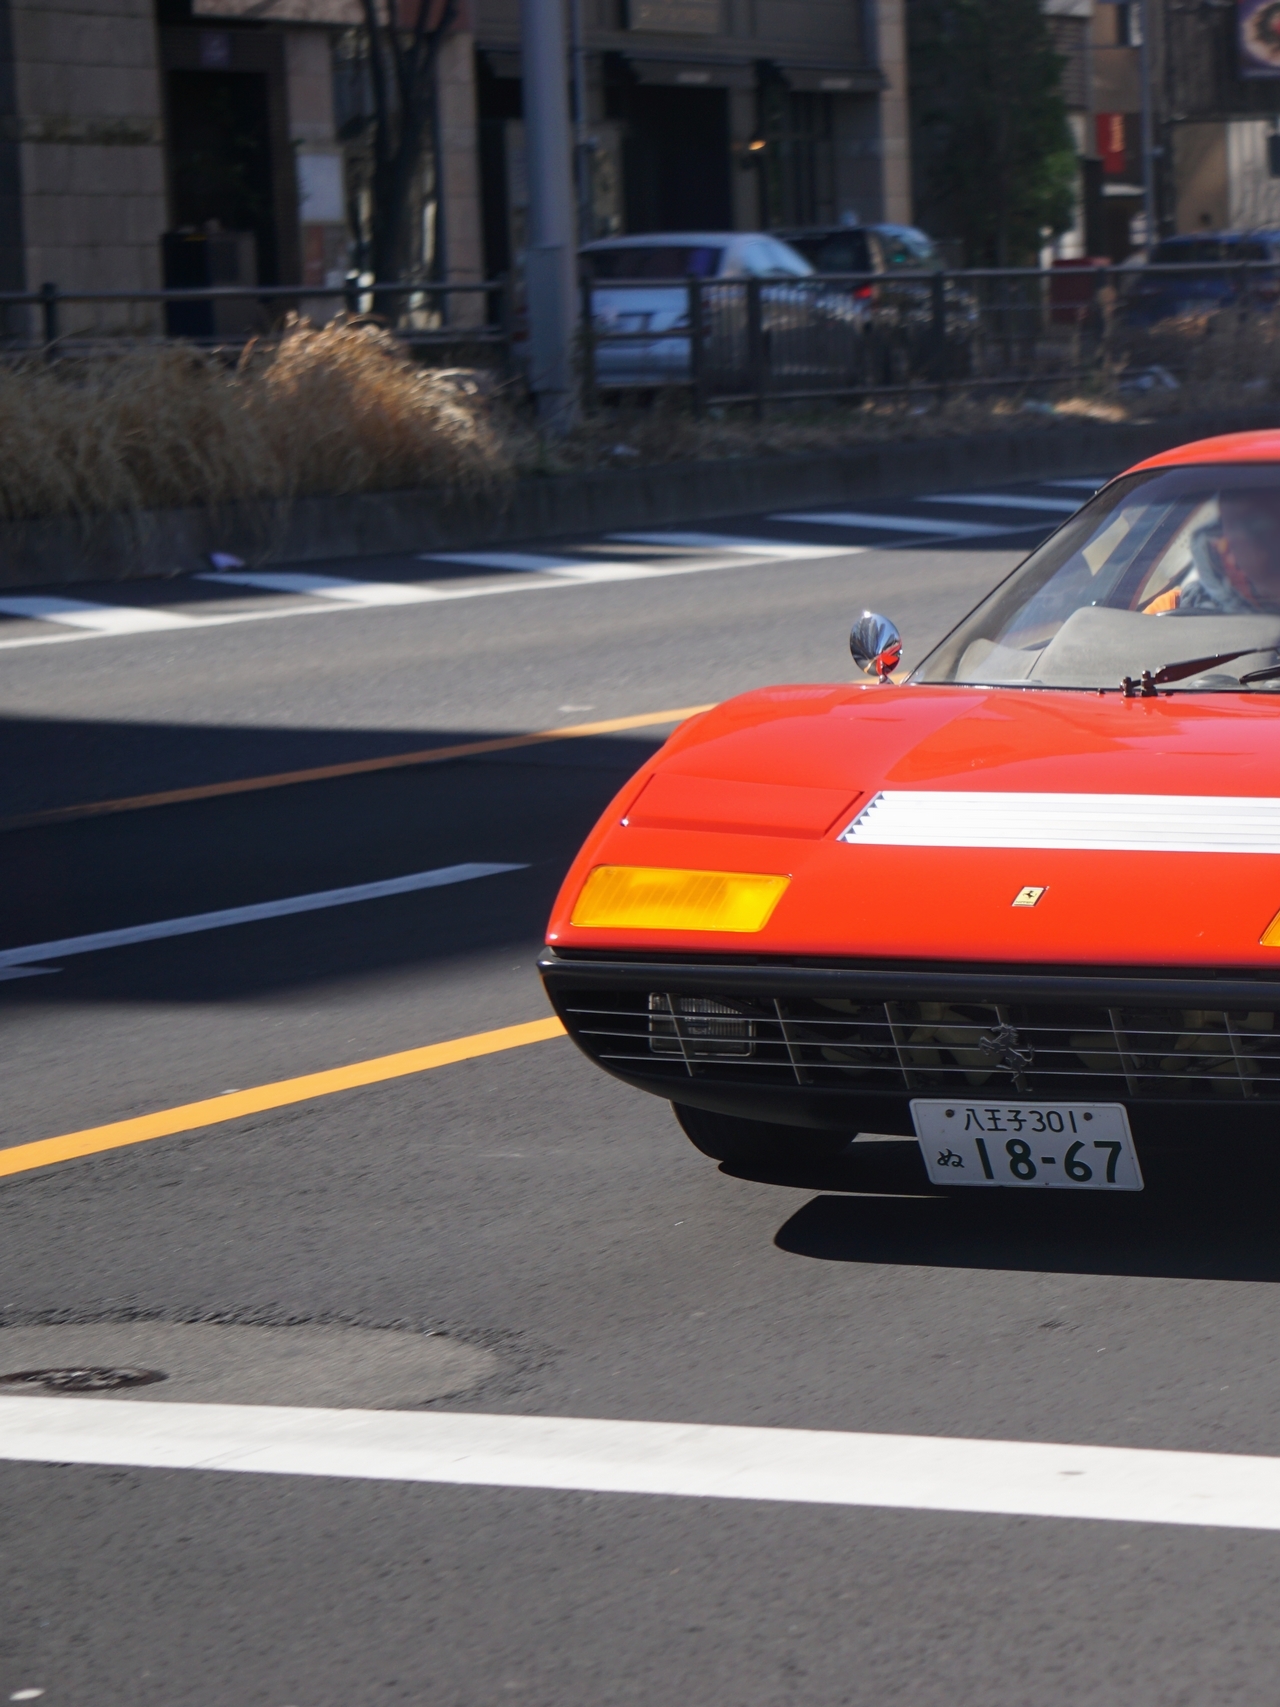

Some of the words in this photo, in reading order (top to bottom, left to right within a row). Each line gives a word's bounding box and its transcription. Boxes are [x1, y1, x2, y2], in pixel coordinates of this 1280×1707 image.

[964, 1108, 1078, 1133] 八王子301
[936, 1148, 965, 1168] ぬ
[975, 1137, 1123, 1184] 18-67
